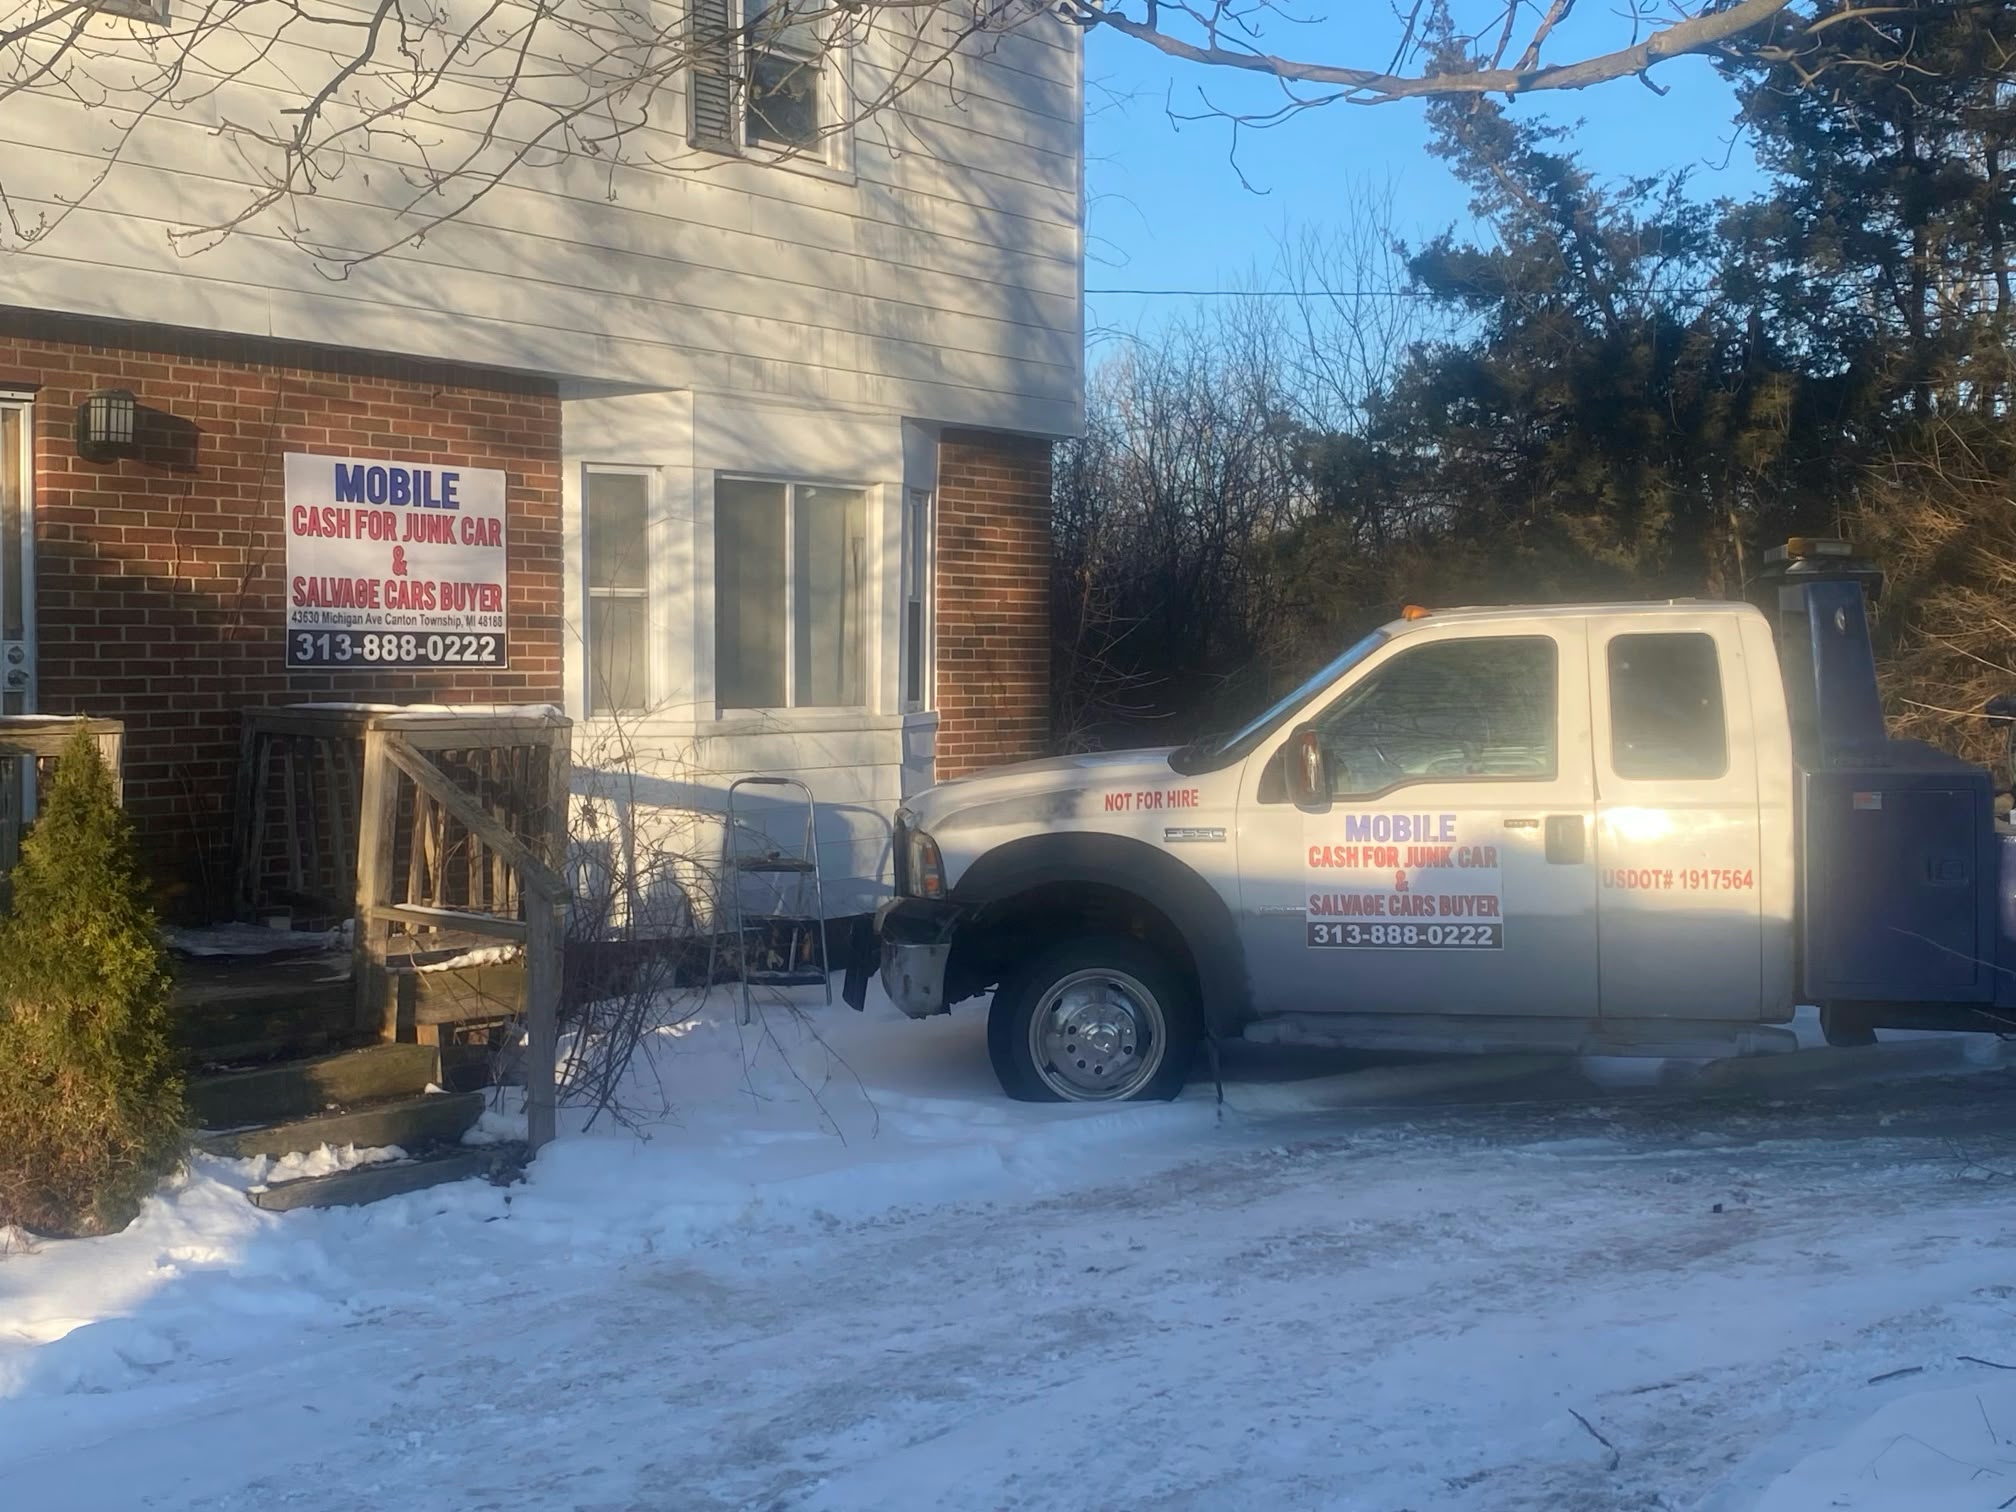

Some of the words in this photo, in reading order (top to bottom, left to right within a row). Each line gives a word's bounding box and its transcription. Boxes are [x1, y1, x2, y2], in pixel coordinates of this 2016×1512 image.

[335, 463, 460, 510] MOBILE
[292, 505, 351, 539] CASH
[355, 509, 397, 541] FOR
[402, 512, 457, 544] JUNK
[461, 516, 502, 547] CAR
[392, 545, 408, 576] &
[292, 576, 380, 609] SALVAGE
[384, 579, 436, 610] CARS
[440, 582, 503, 612] BUYER
[321, 612, 363, 628] Michigan
[365, 613, 382, 625] Ave
[384, 614, 417, 626] Canton
[419, 614, 464, 629] Township,
[466, 616, 476, 627] MI
[296, 633, 496, 662] 313-888-0222
[1104, 793, 1132, 811] NOT
[1136, 791, 1163, 810] FOR
[1167, 789, 1199, 808] HIRE
[1345, 814, 1457, 843] MOBILE
[1308, 846, 1359, 868] CASH
[1362, 846, 1400, 868] FOR
[1404, 846, 1454, 868] JUNK
[1457, 846, 1498, 868] CAR
[1395, 870, 1409, 892] &
[1602, 869, 1673, 889] USDOT#
[1679, 869, 1753, 889] 1917564
[1309, 894, 1386, 916] SALVAGE
[1389, 895, 1436, 917] CARS
[1439, 895, 1500, 917] BUYER
[1314, 924, 1493, 945] 313-888-0222
